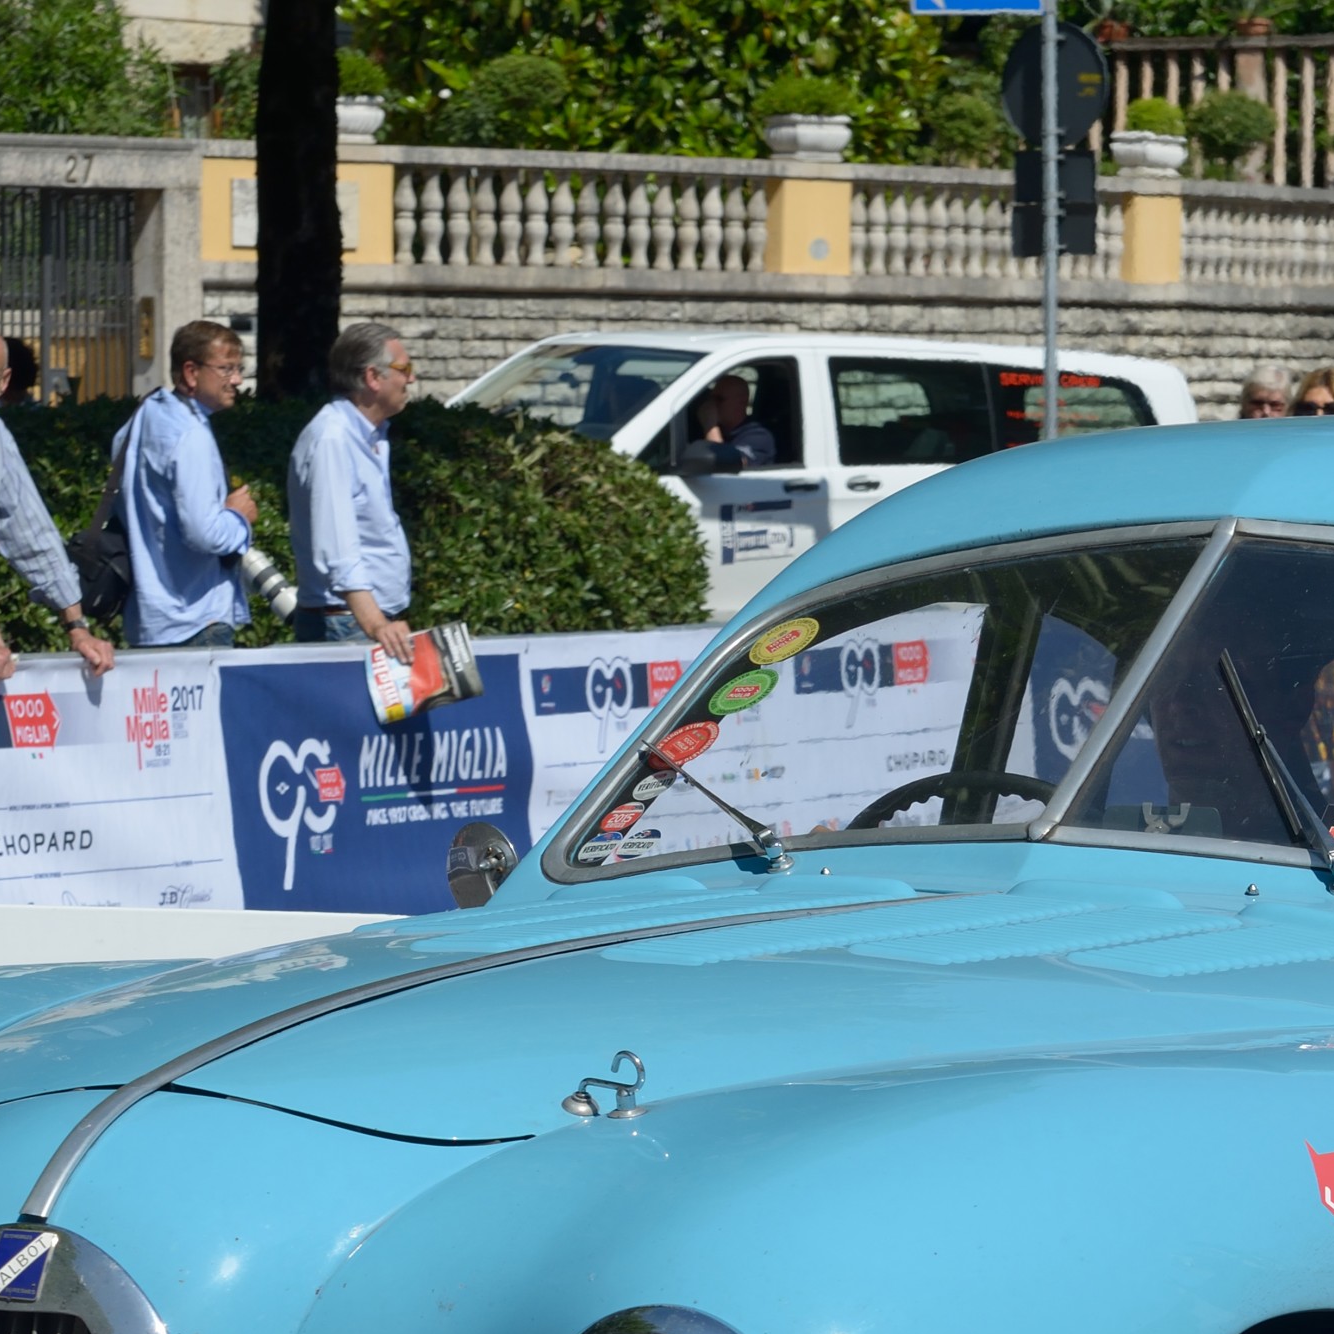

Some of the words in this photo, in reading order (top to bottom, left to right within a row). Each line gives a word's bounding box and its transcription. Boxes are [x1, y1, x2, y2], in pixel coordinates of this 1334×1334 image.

[66, 154, 95, 184] 27
[898, 646, 923, 661] 1000
[652, 666, 676, 681] 1000
[133, 669, 168, 714] Mille
[171, 685, 204, 712] 2017
[10, 700, 45, 718] 1000
[16, 727, 51, 744] MIGLIA
[126, 714, 170, 771] Miglia
[359, 733, 424, 788] MILLE
[431, 726, 507, 783] MIGLIA
[886, 750, 948, 772] CHOPARD
[320, 772, 337, 783] 1000
[637, 777, 674, 792] VERIFICATO
[607, 813, 635, 823] 2015
[582, 843, 617, 854] VERIFICATO
[621, 841, 655, 850] VERIFICATO
